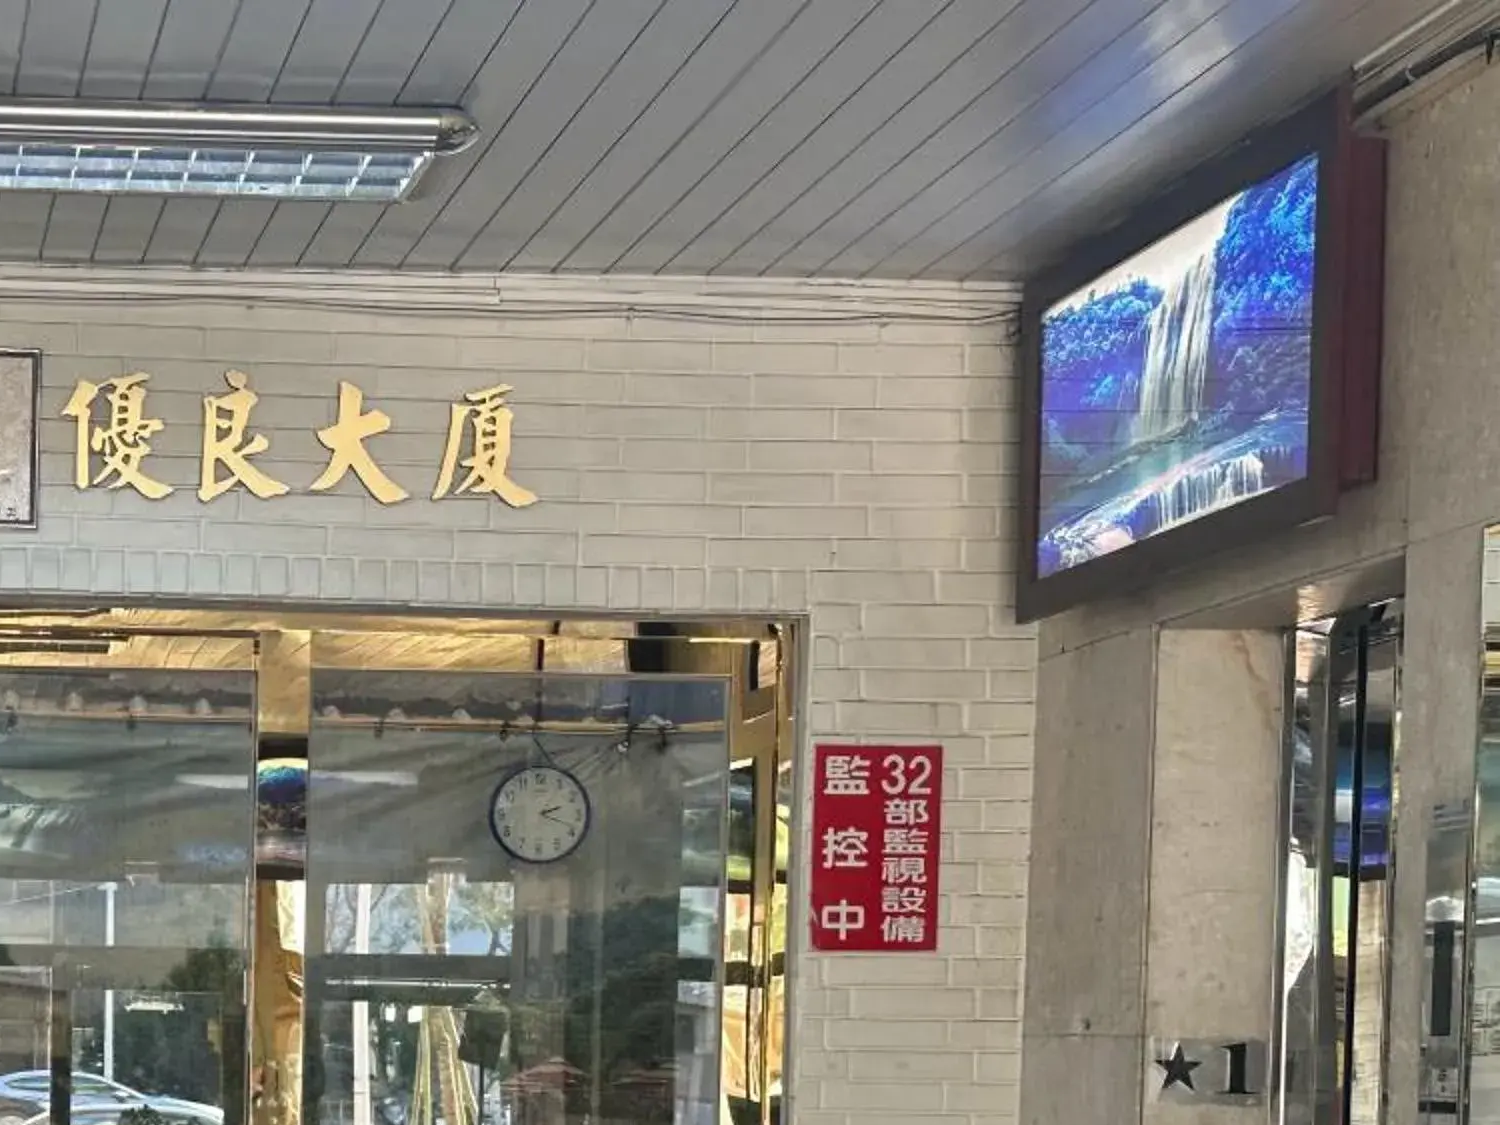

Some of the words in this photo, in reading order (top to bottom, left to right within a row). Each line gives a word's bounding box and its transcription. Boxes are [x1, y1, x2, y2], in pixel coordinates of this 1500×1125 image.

[821, 754, 871, 941] 監控中
[1214, 1042, 1261, 1095] 1
